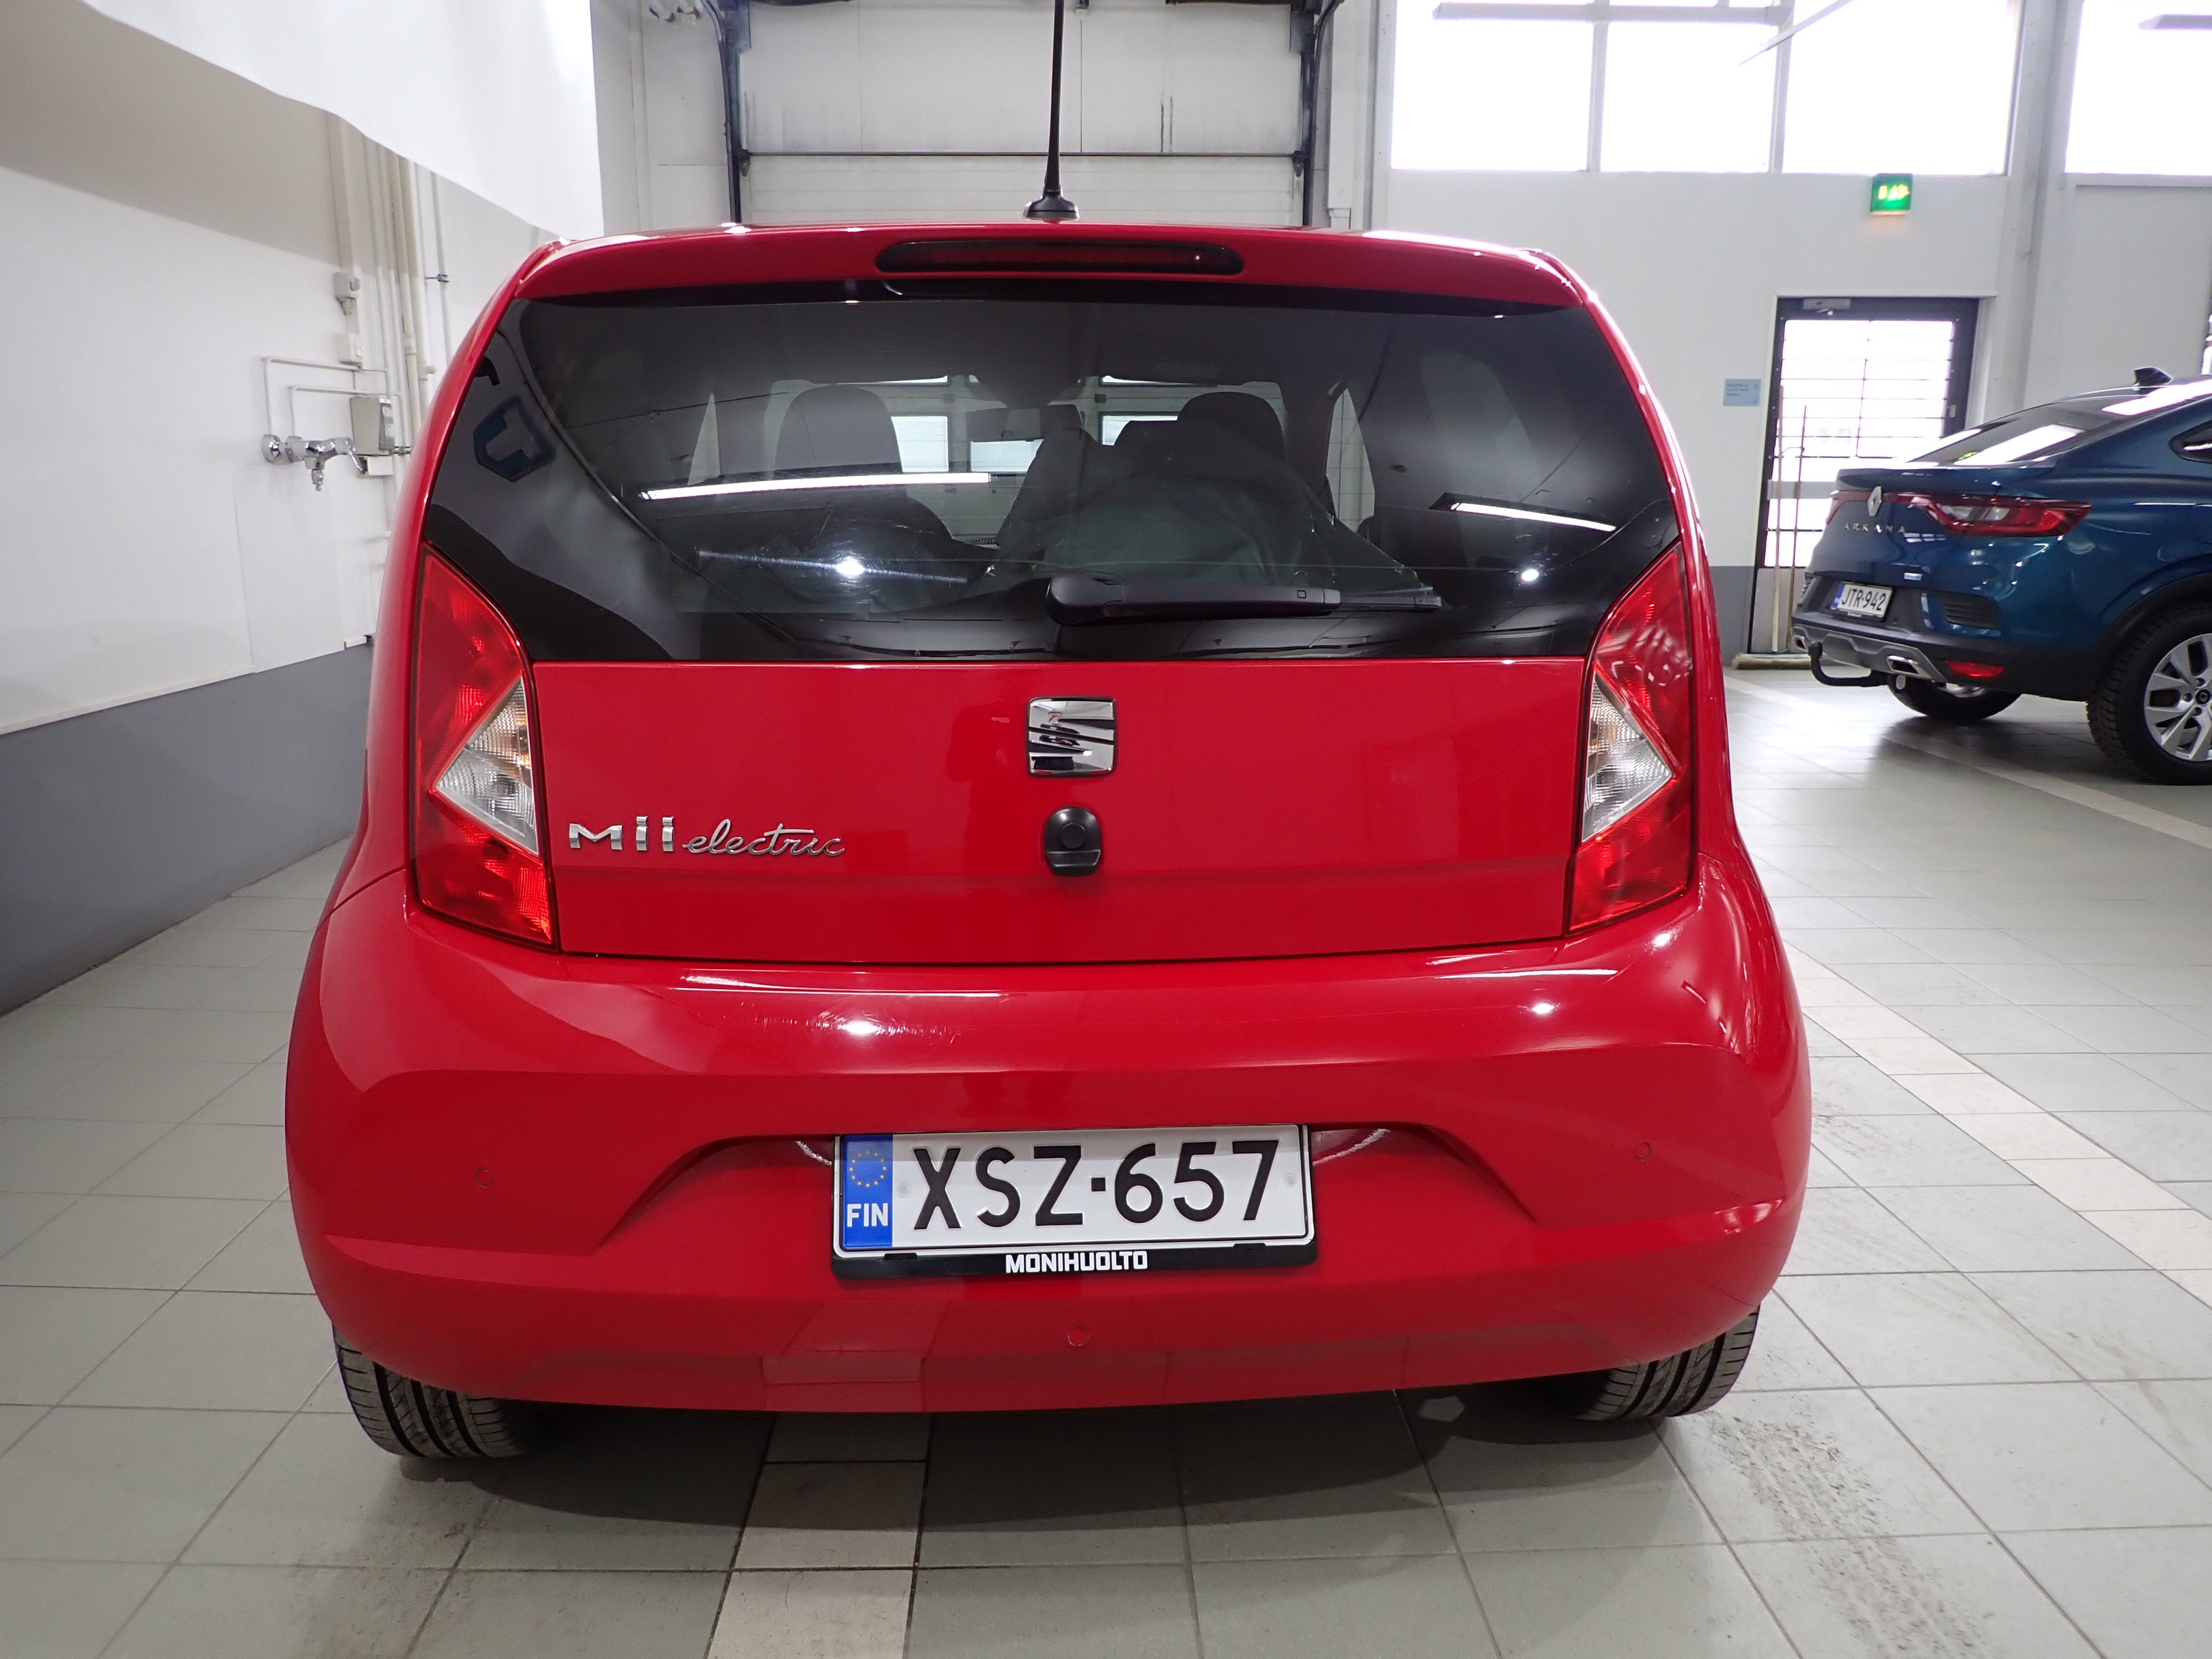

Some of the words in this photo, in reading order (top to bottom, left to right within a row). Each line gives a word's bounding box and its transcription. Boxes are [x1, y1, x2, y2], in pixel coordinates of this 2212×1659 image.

[682, 818, 844, 857] electric
[847, 1203, 889, 1227] FIN
[913, 1140, 1279, 1230] XSZ-657
[1005, 1251, 1147, 1274] MONIHUOLTO
